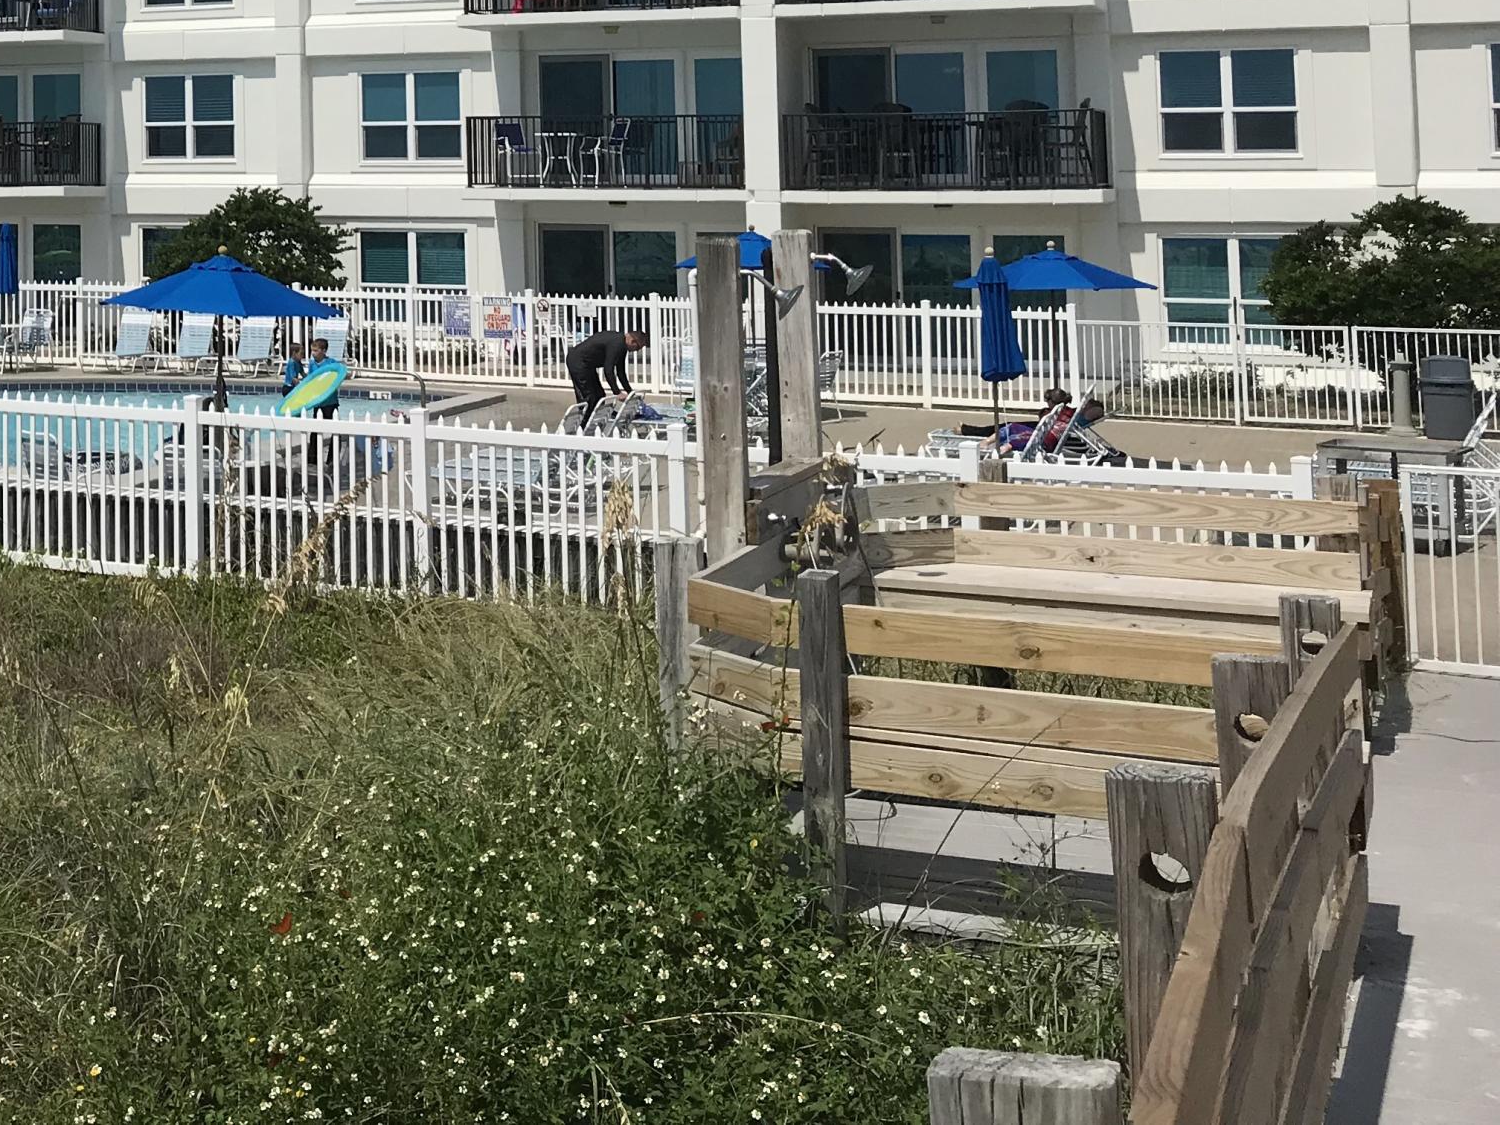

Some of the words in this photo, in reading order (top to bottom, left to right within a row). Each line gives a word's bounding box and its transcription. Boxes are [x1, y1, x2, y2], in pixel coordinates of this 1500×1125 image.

[484, 297, 511, 306] WARNING
[493, 306, 501, 314] NO
[484, 314, 511, 322] LIFEGUARD
[495, 322, 508, 330] DUTY
